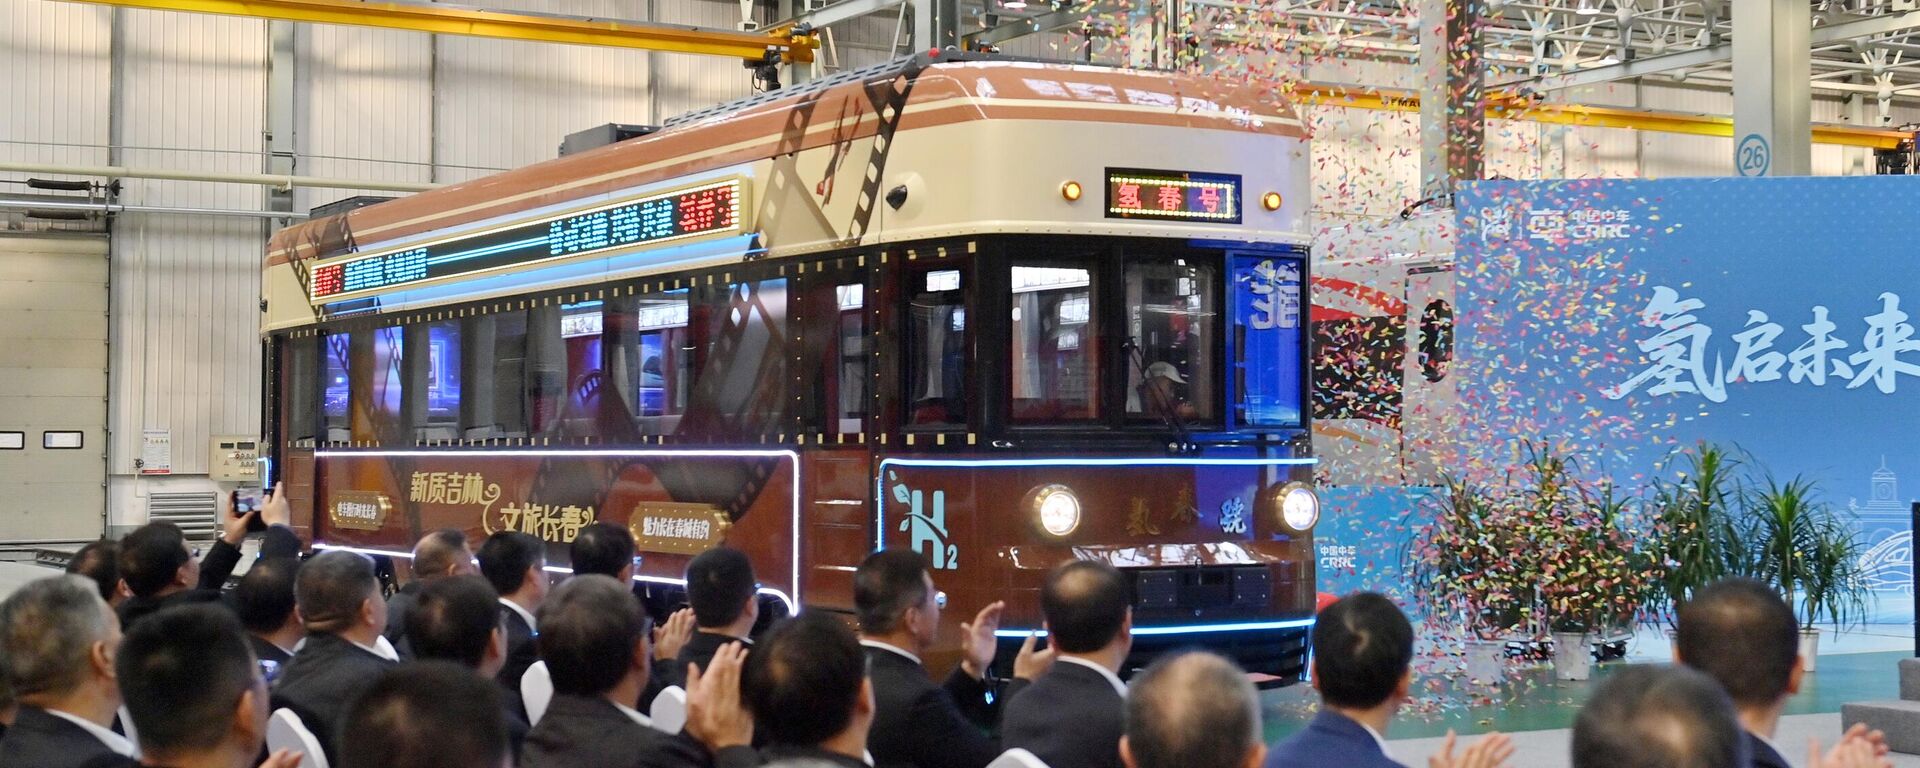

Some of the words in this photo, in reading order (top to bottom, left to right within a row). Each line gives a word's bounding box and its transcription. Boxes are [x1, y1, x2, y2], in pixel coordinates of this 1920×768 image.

[1743, 145, 1764, 170] 26
[1119, 181, 1220, 213] 氢春号
[1572, 224, 1631, 239] CRRC
[1600, 285, 1920, 403] 氢启未来
[410, 471, 484, 505] 新质吉林
[500, 502, 586, 544] 文旅长春
[1320, 545, 1356, 556] 中国中车
[1320, 556, 1356, 569] CRRC
